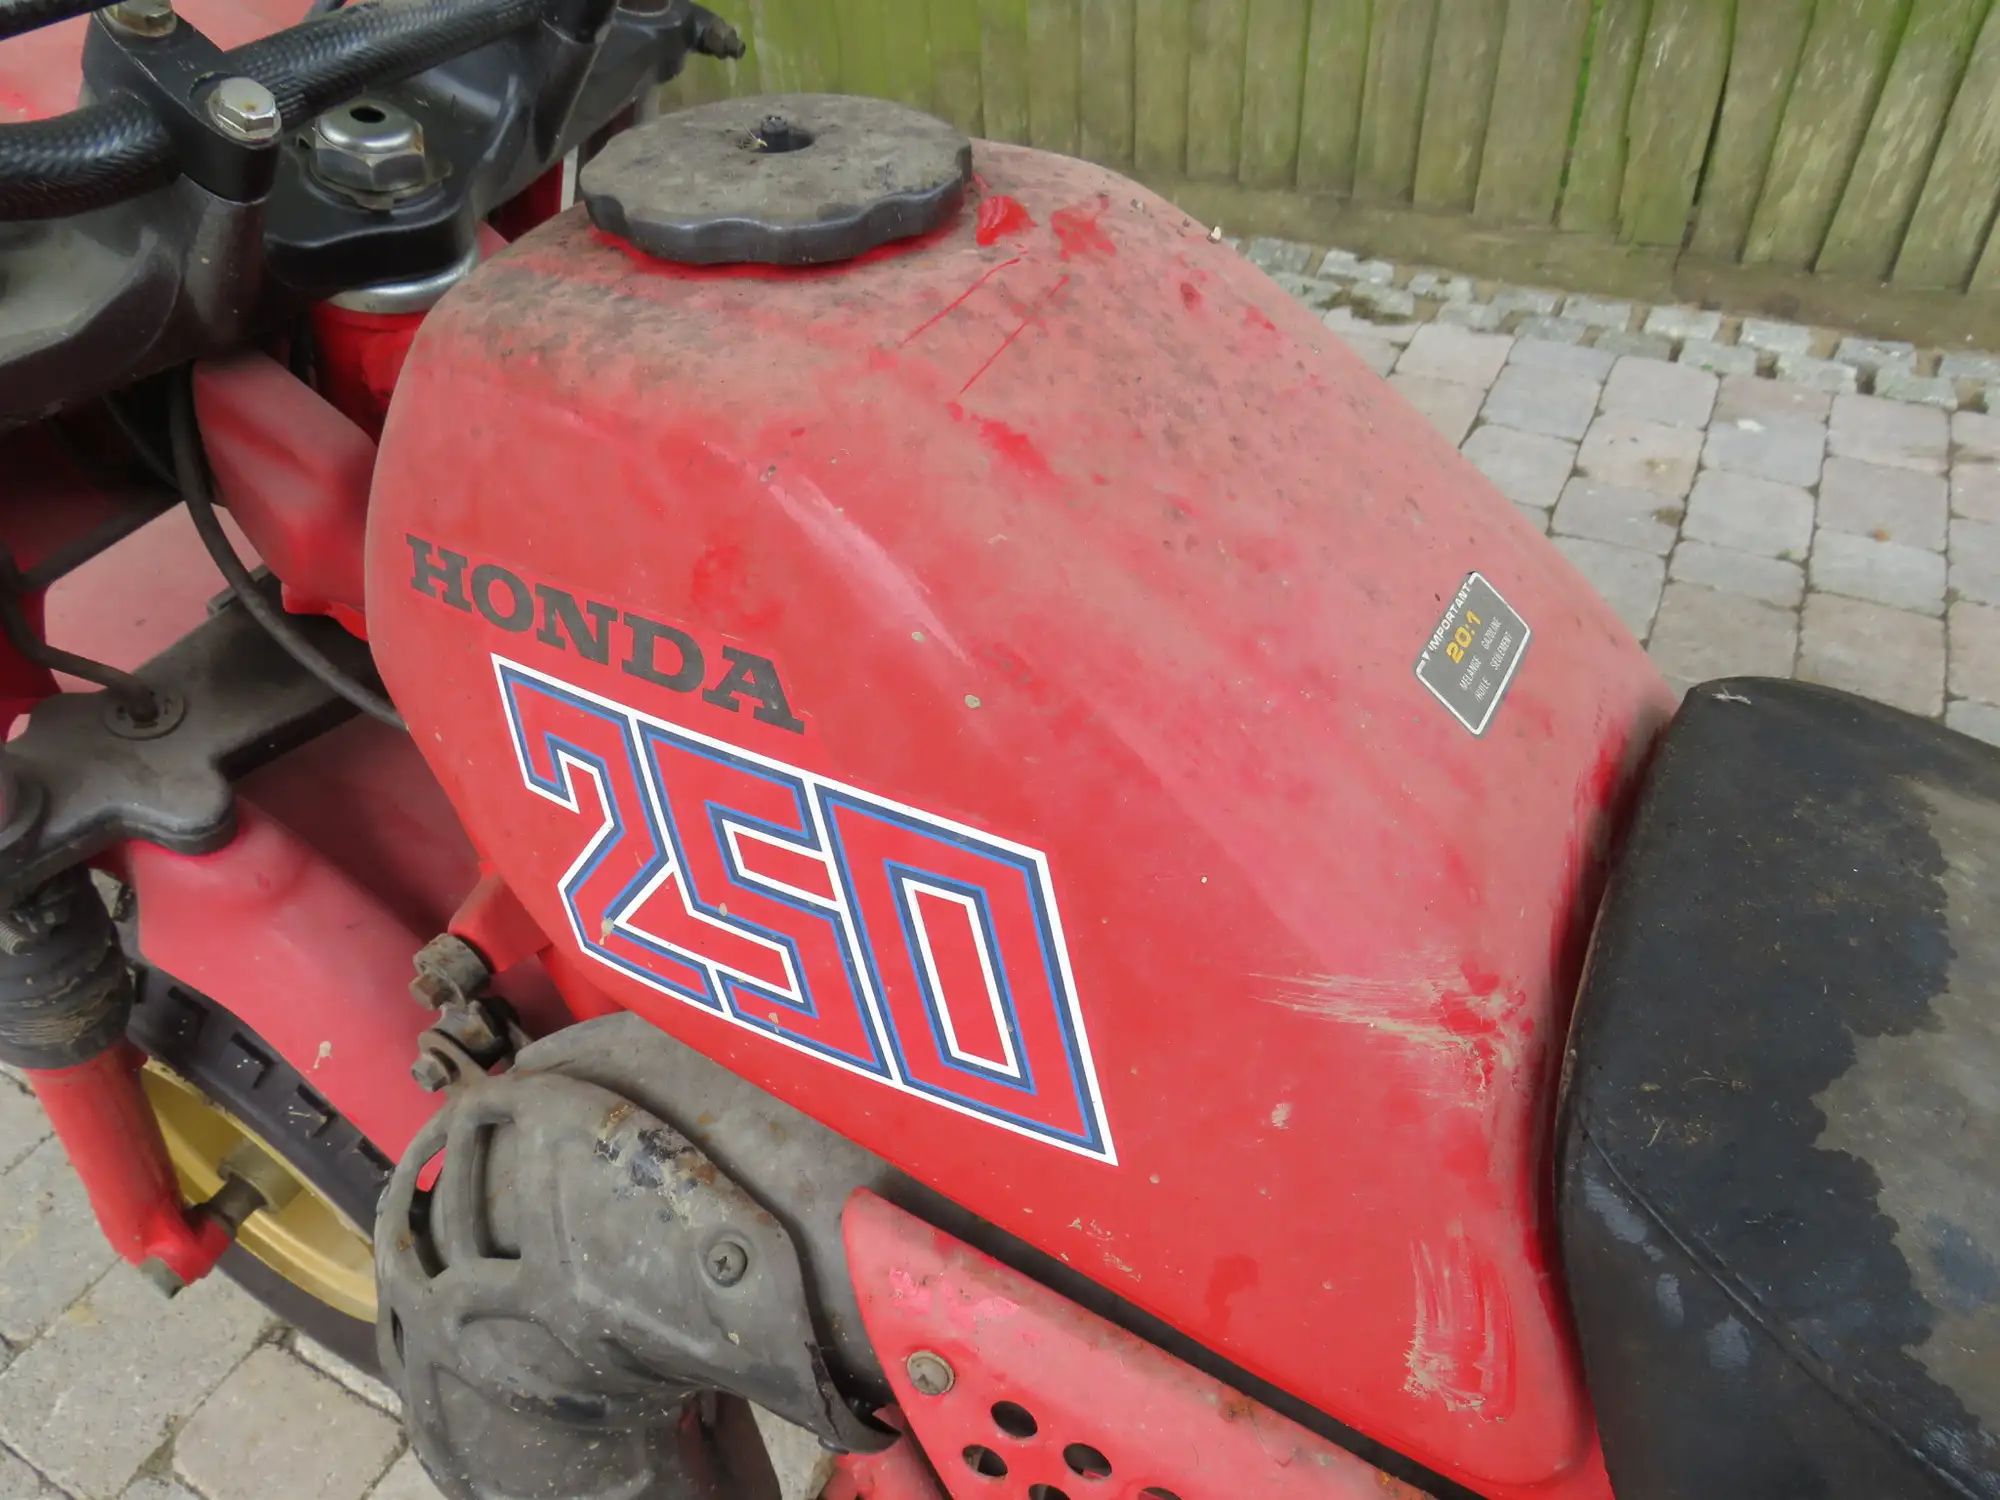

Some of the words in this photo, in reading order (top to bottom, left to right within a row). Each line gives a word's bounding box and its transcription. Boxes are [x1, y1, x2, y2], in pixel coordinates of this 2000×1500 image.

[406, 533, 804, 735] HONDA
[1428, 582, 1471, 652] IMPORTANT
[1446, 610, 1481, 664] 20:1
[490, 652, 1119, 1167] 250
